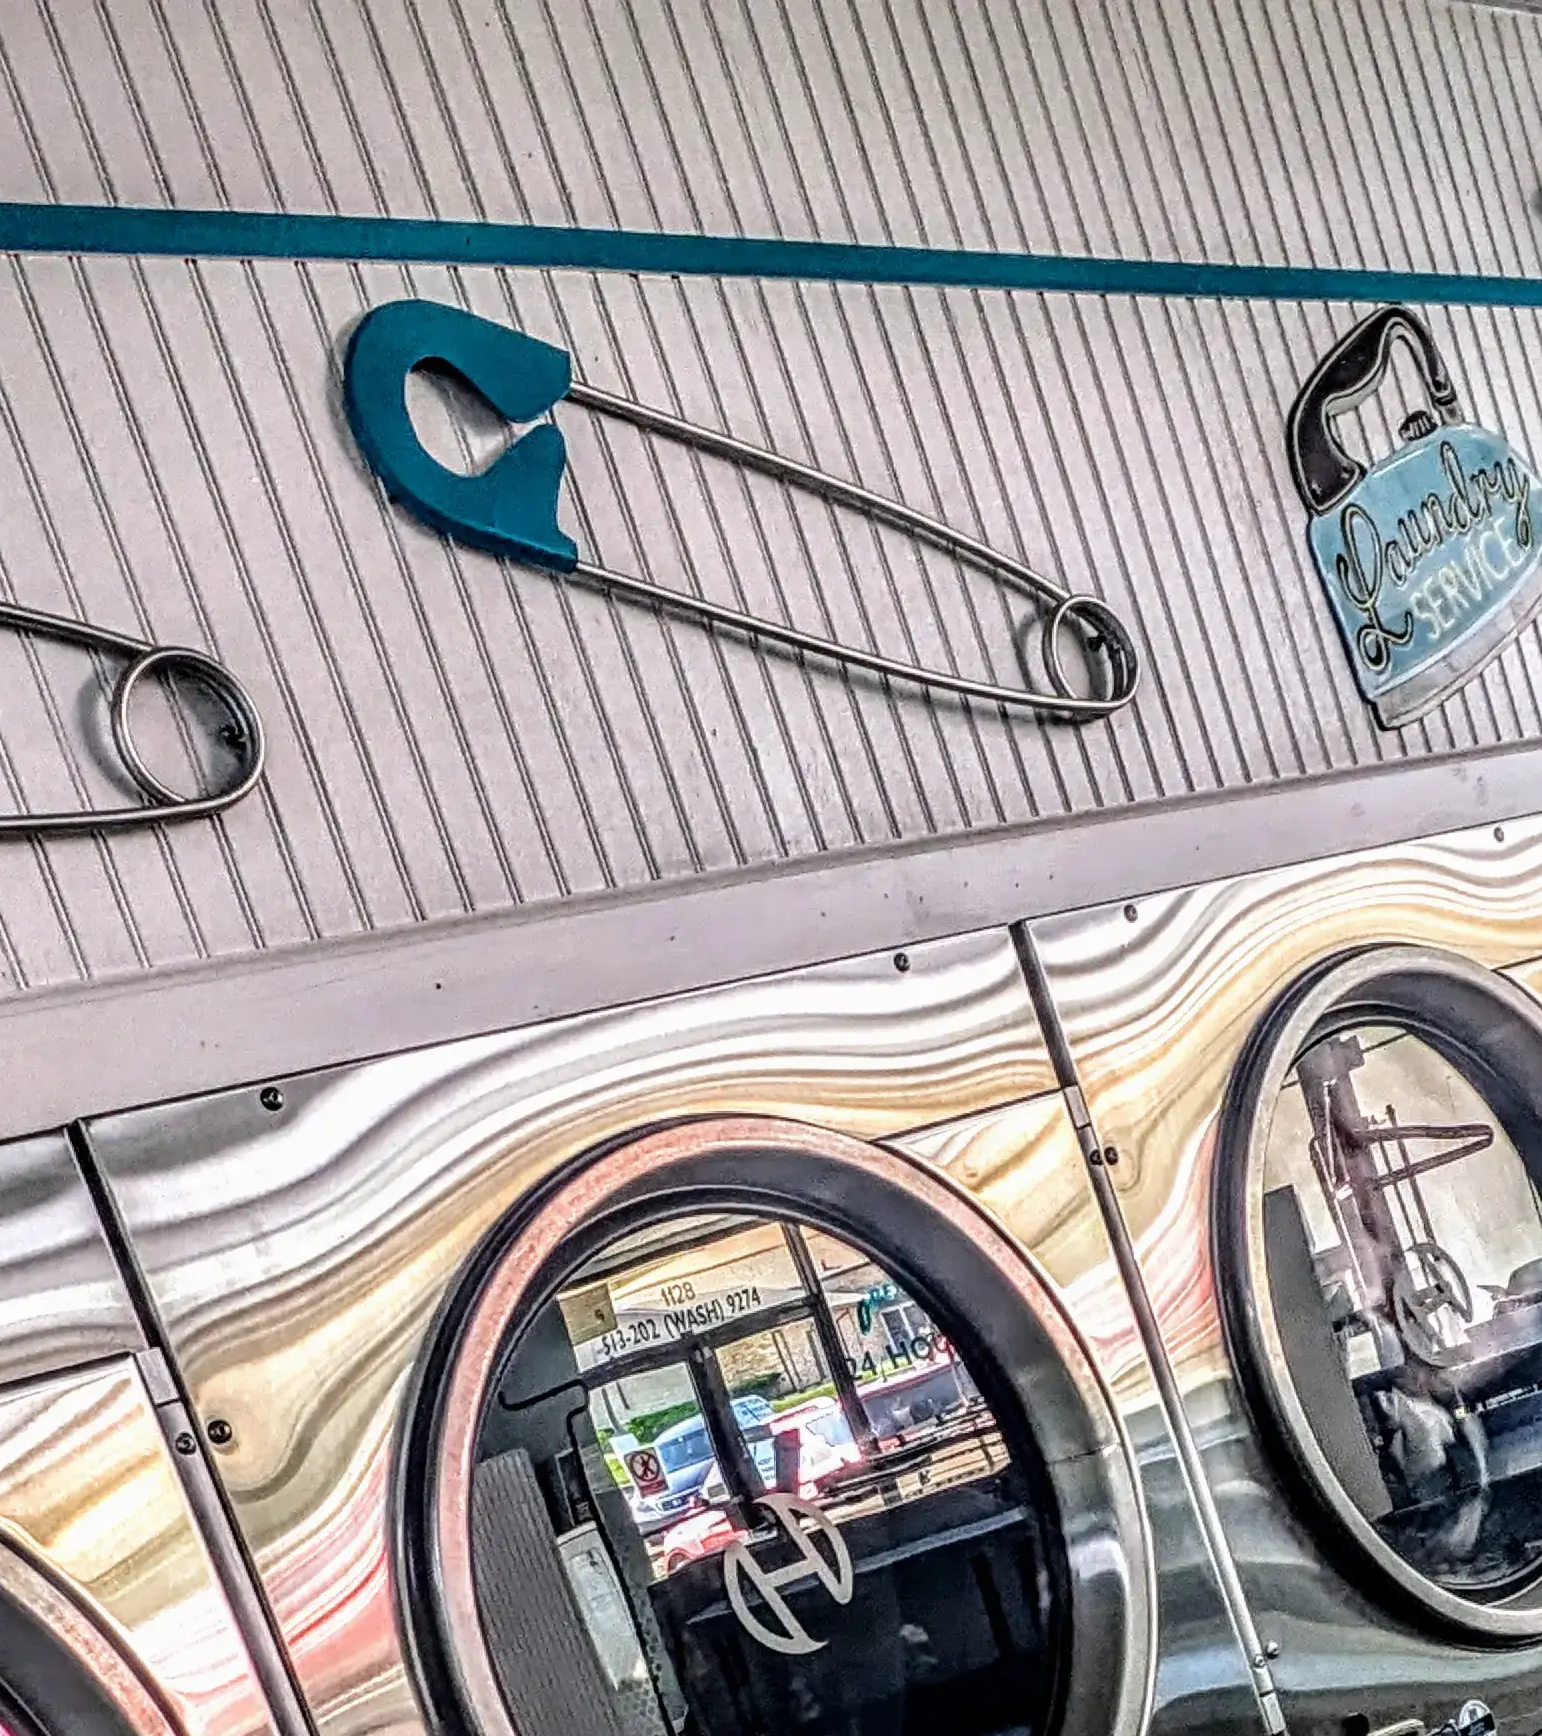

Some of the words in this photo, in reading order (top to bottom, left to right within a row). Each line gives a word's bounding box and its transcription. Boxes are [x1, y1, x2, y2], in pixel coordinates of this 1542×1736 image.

[1336, 441, 1534, 675] Laundry
[1410, 517, 1523, 643] SERVICE
[663, 1302, 725, 1339] (WASH)
[726, 1287, 761, 1314] 9274
